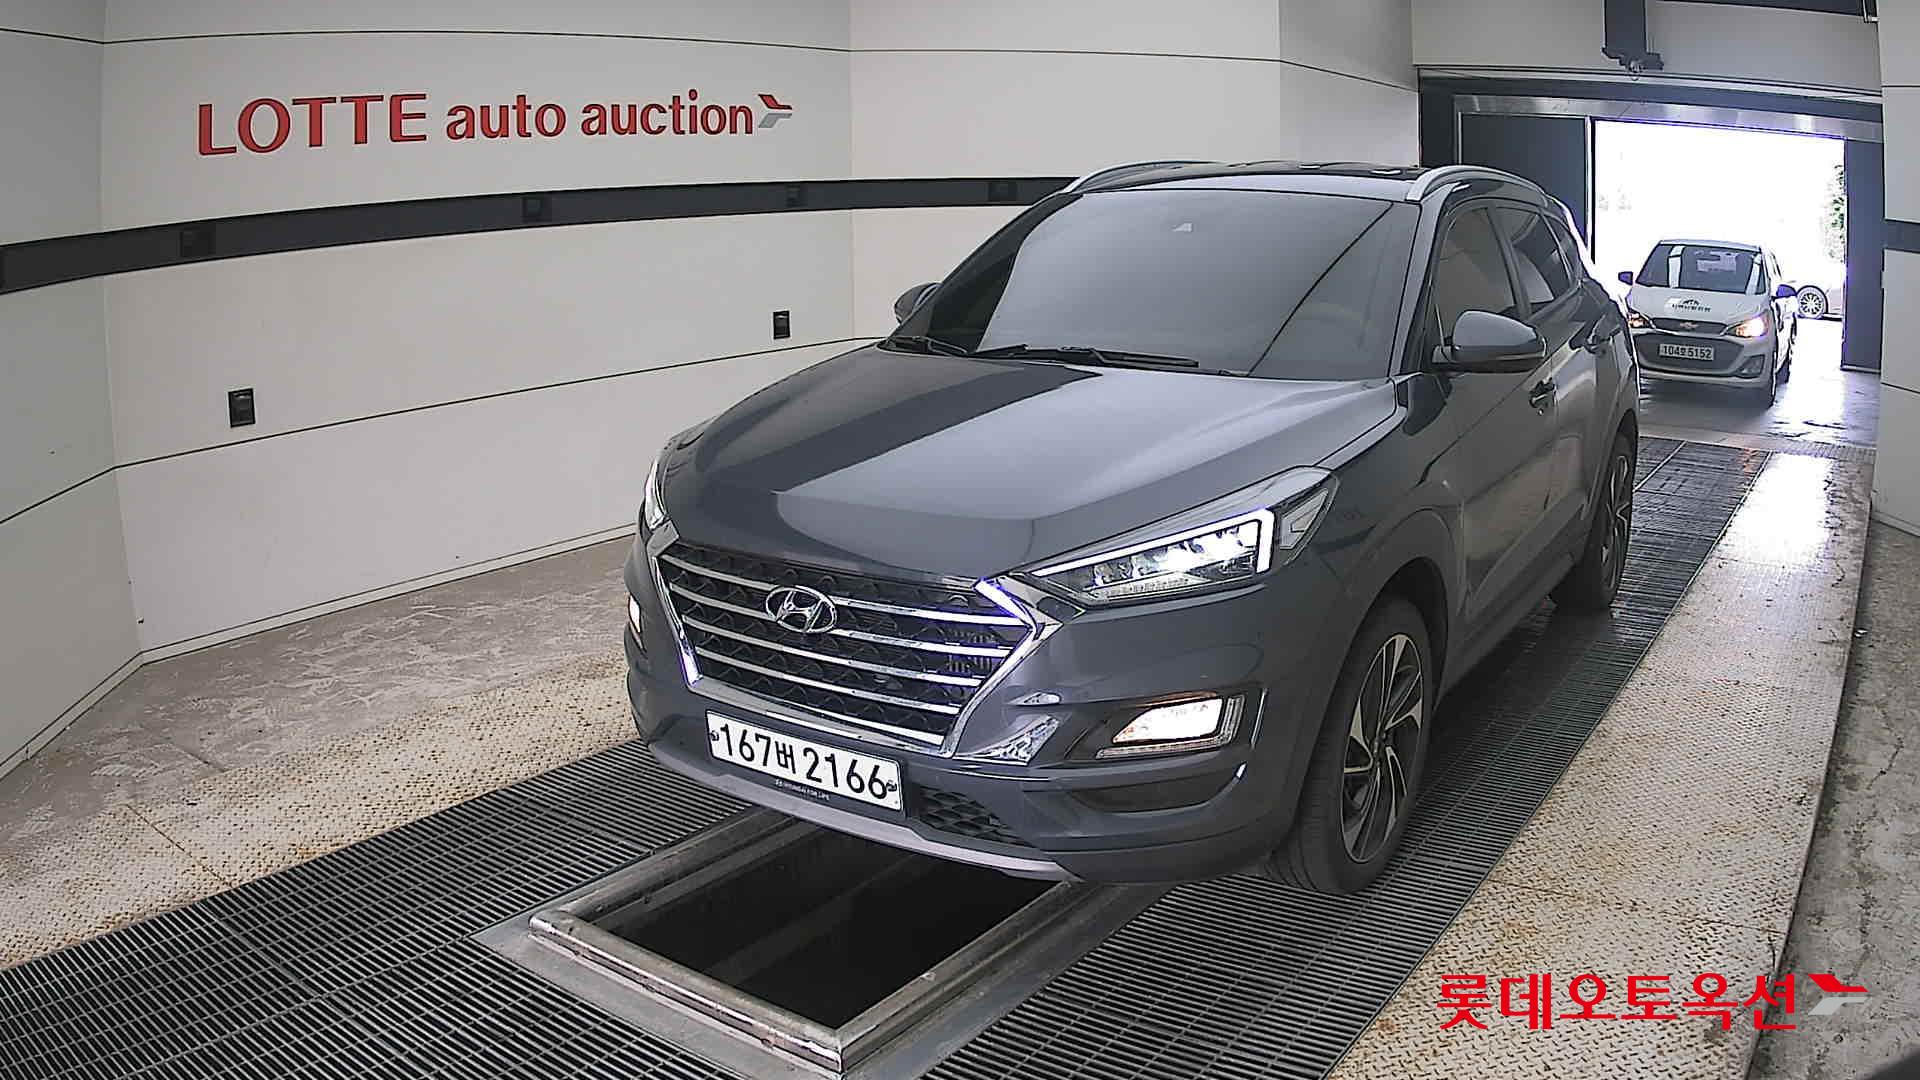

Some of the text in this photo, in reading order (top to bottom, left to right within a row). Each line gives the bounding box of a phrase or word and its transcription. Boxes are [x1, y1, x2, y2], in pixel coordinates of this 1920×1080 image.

[198, 89, 753, 156] LOTTE auto auction
